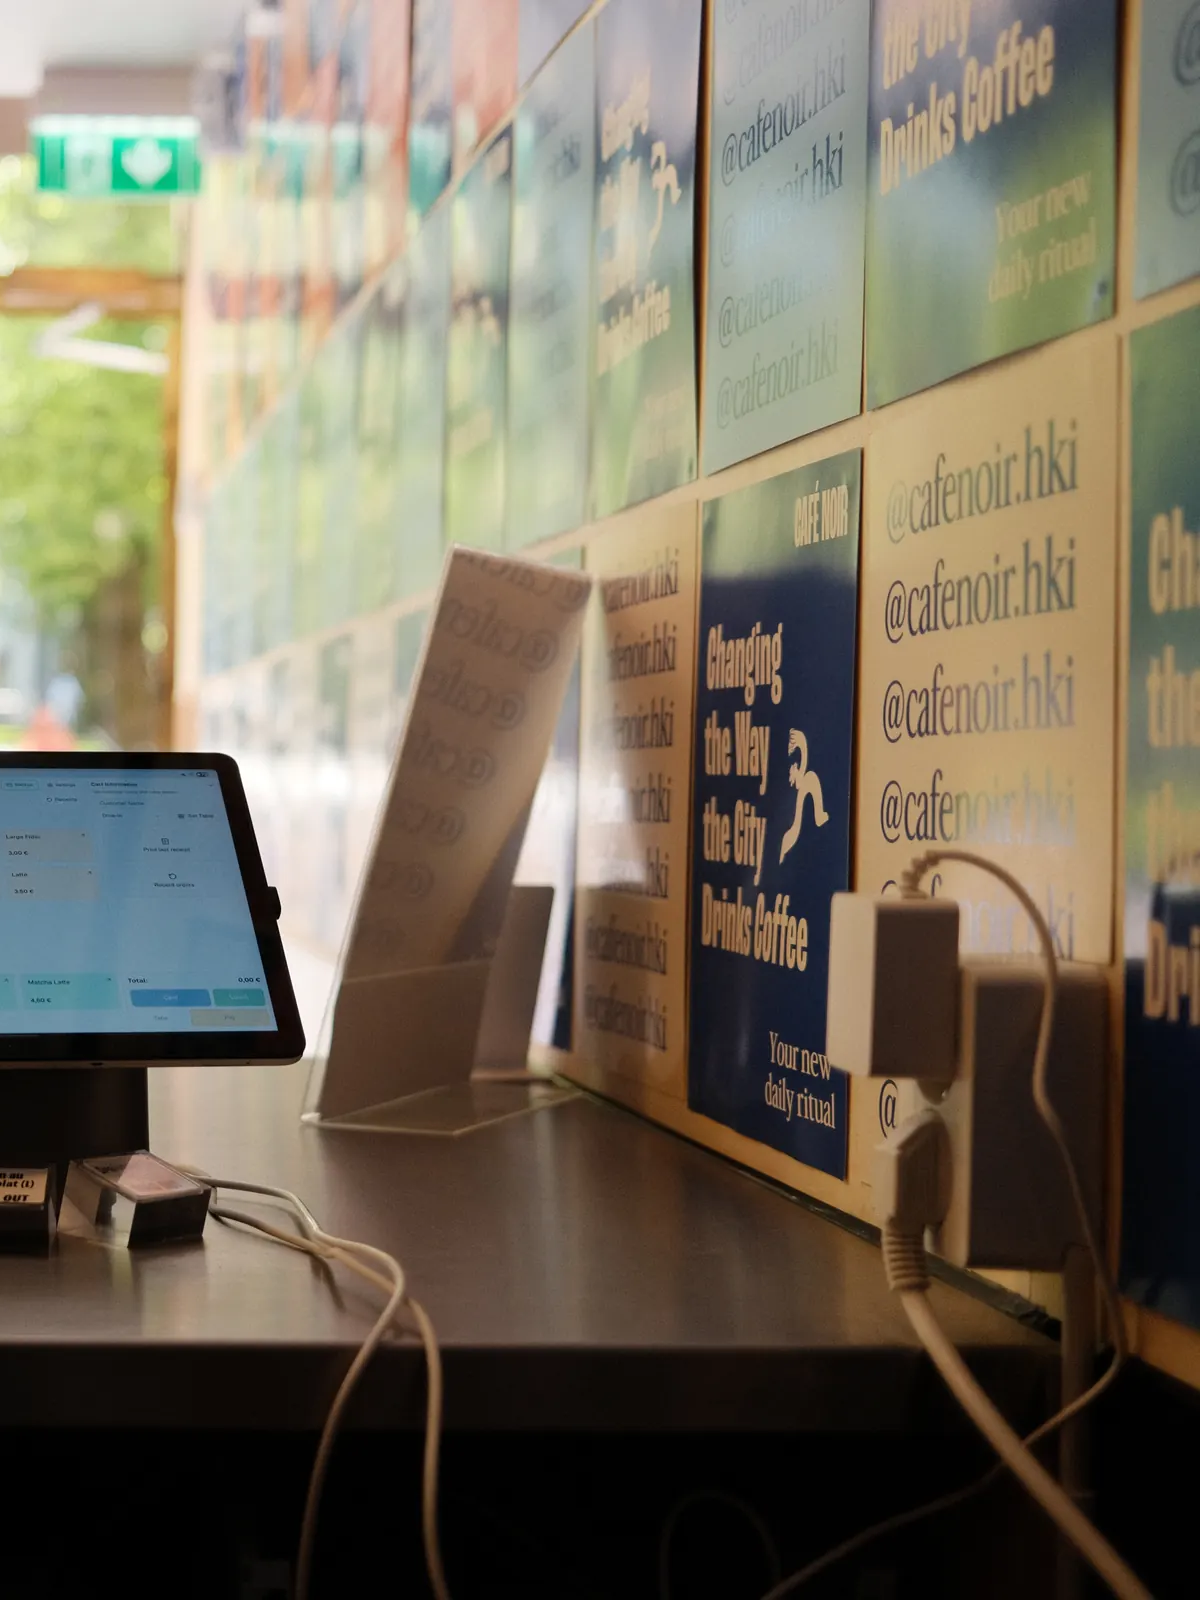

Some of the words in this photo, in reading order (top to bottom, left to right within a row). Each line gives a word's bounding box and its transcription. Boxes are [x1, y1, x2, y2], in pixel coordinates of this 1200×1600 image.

[721, 38, 846, 188] @cafenoir.hki
[880, 81, 956, 197] Drinks
[961, 20, 1056, 144] Coffee
[1039, 215, 1097, 283] ritual
[794, 479, 821, 548] CAFÉ
[822, 484, 849, 541] NOIR
[887, 417, 1079, 545] @cafenoir.hki
[885, 533, 1077, 643] @cafenoir.hki
[706, 621, 783, 706] Changing
[883, 648, 1076, 744] @cafenoir.hki
[704, 710, 732, 776] the
[734, 711, 770, 796] Way
[703, 796, 731, 863] the
[734, 800, 767, 887] City
[701, 882, 752, 957] Drinks
[754, 892, 809, 971] Coffee
[769, 1030, 799, 1069] Your
[801, 1050, 832, 1081] new
[764, 1073, 794, 1121] daily
[797, 1086, 836, 1129] ritual
[3, 1194, 30, 1202] OUT
[9, 1172, 24, 1180] au
